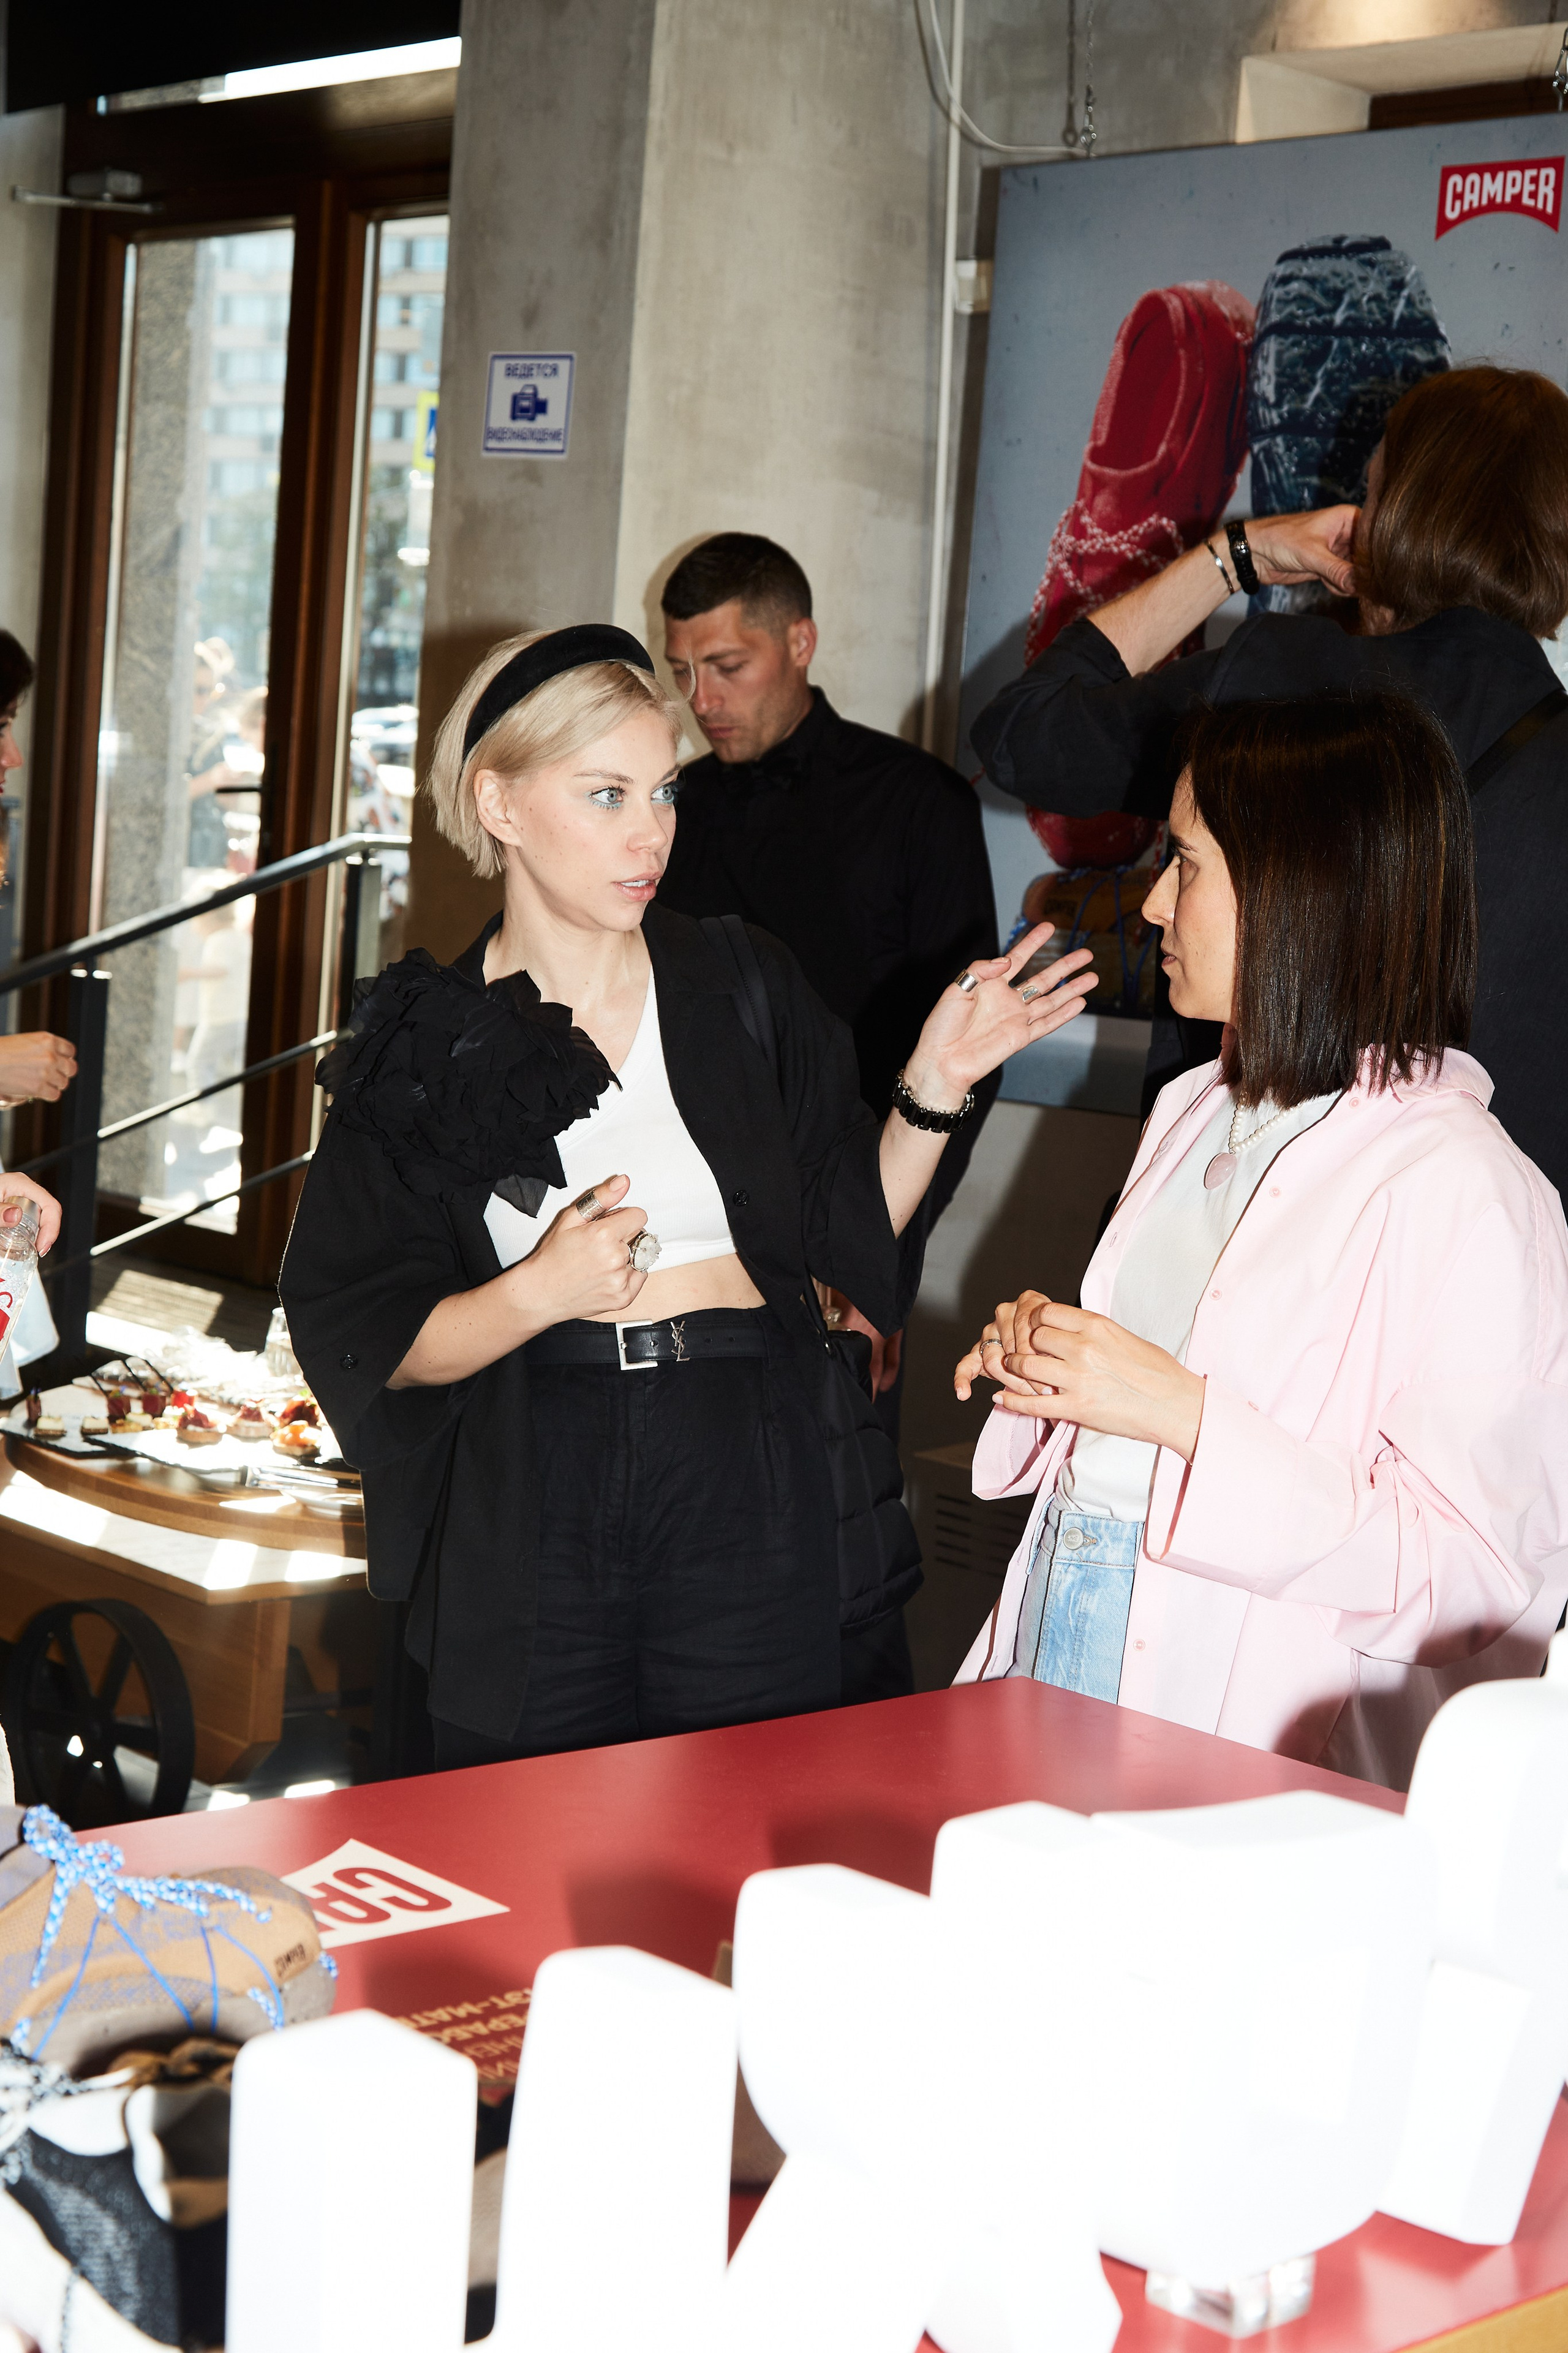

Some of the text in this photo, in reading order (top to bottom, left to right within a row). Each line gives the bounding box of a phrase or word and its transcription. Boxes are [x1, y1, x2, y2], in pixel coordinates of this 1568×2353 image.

[1444, 166, 1556, 221] CAMPER
[503, 363, 559, 379] ВЕДЕТСЯ
[487, 426, 562, 443] ВИДЕОНАБЛЮДЕНИЕ
